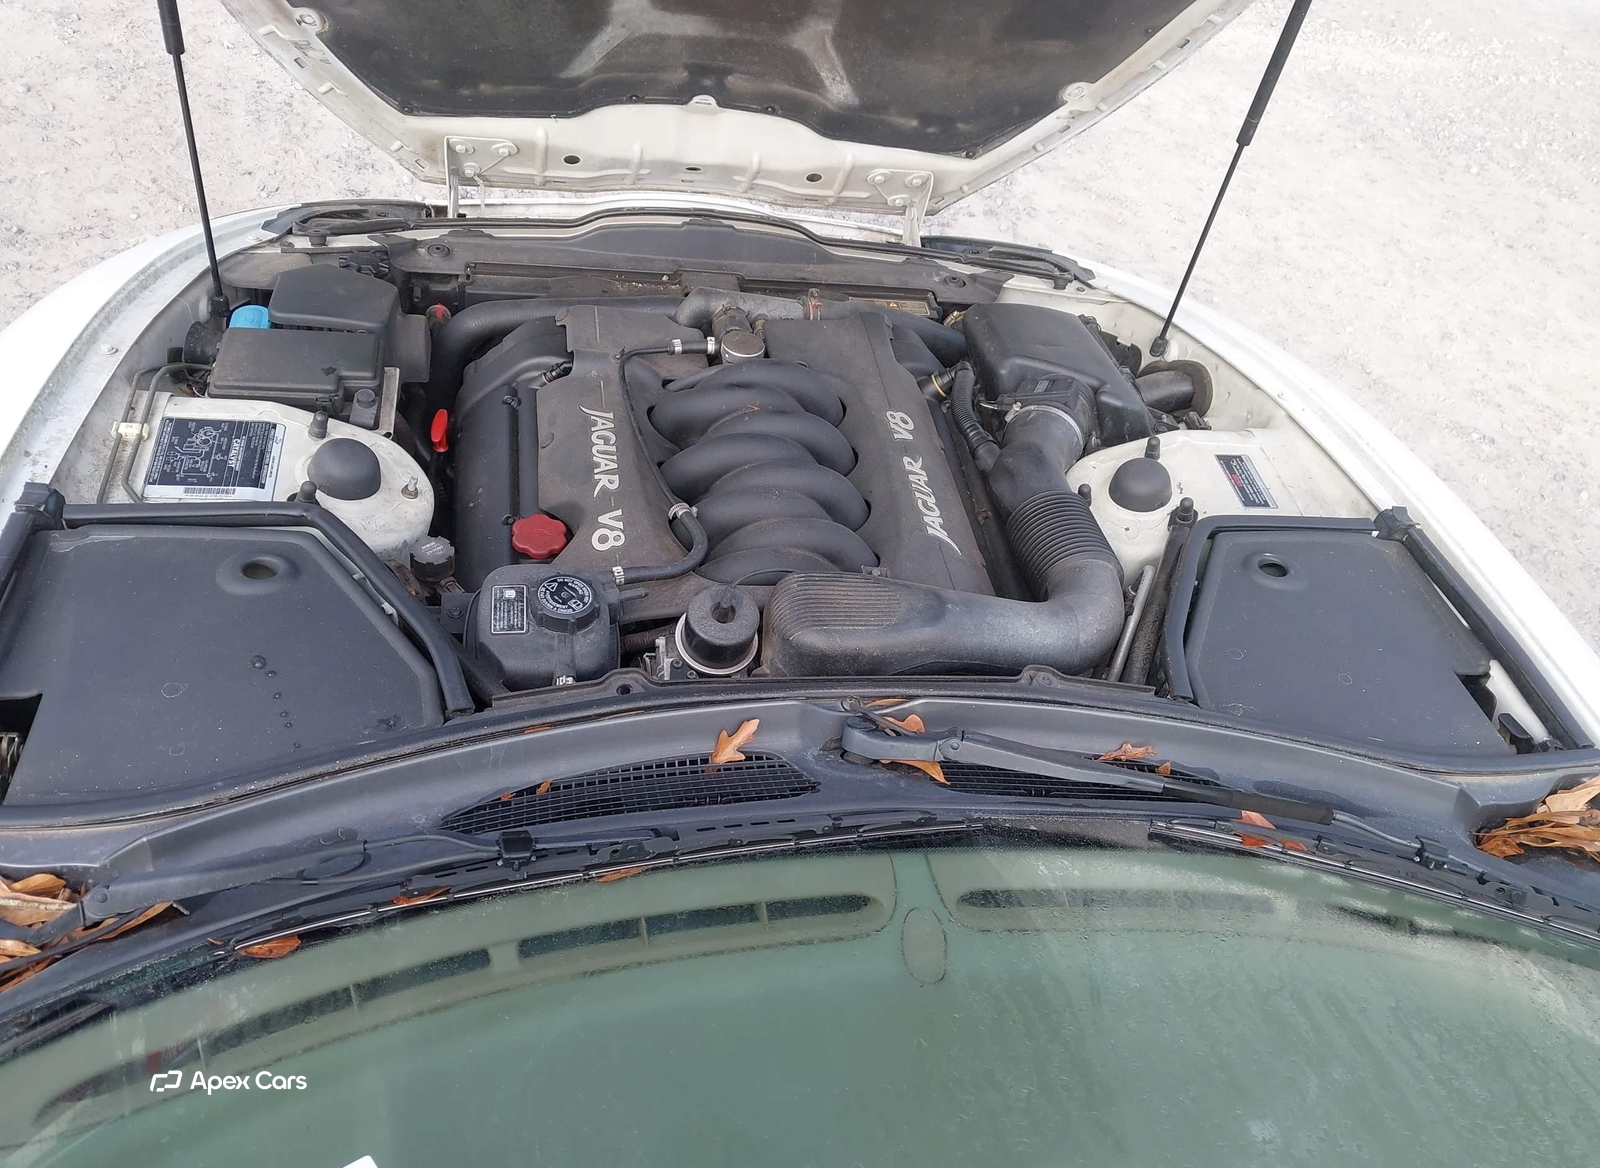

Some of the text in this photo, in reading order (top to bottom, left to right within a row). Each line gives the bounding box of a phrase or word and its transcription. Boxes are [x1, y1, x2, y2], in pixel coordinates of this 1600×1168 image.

[228, 438, 241, 468] CATALYST
[578, 404, 626, 552] JAGUAR V8
[885, 410, 962, 556] JAGUAR V8
